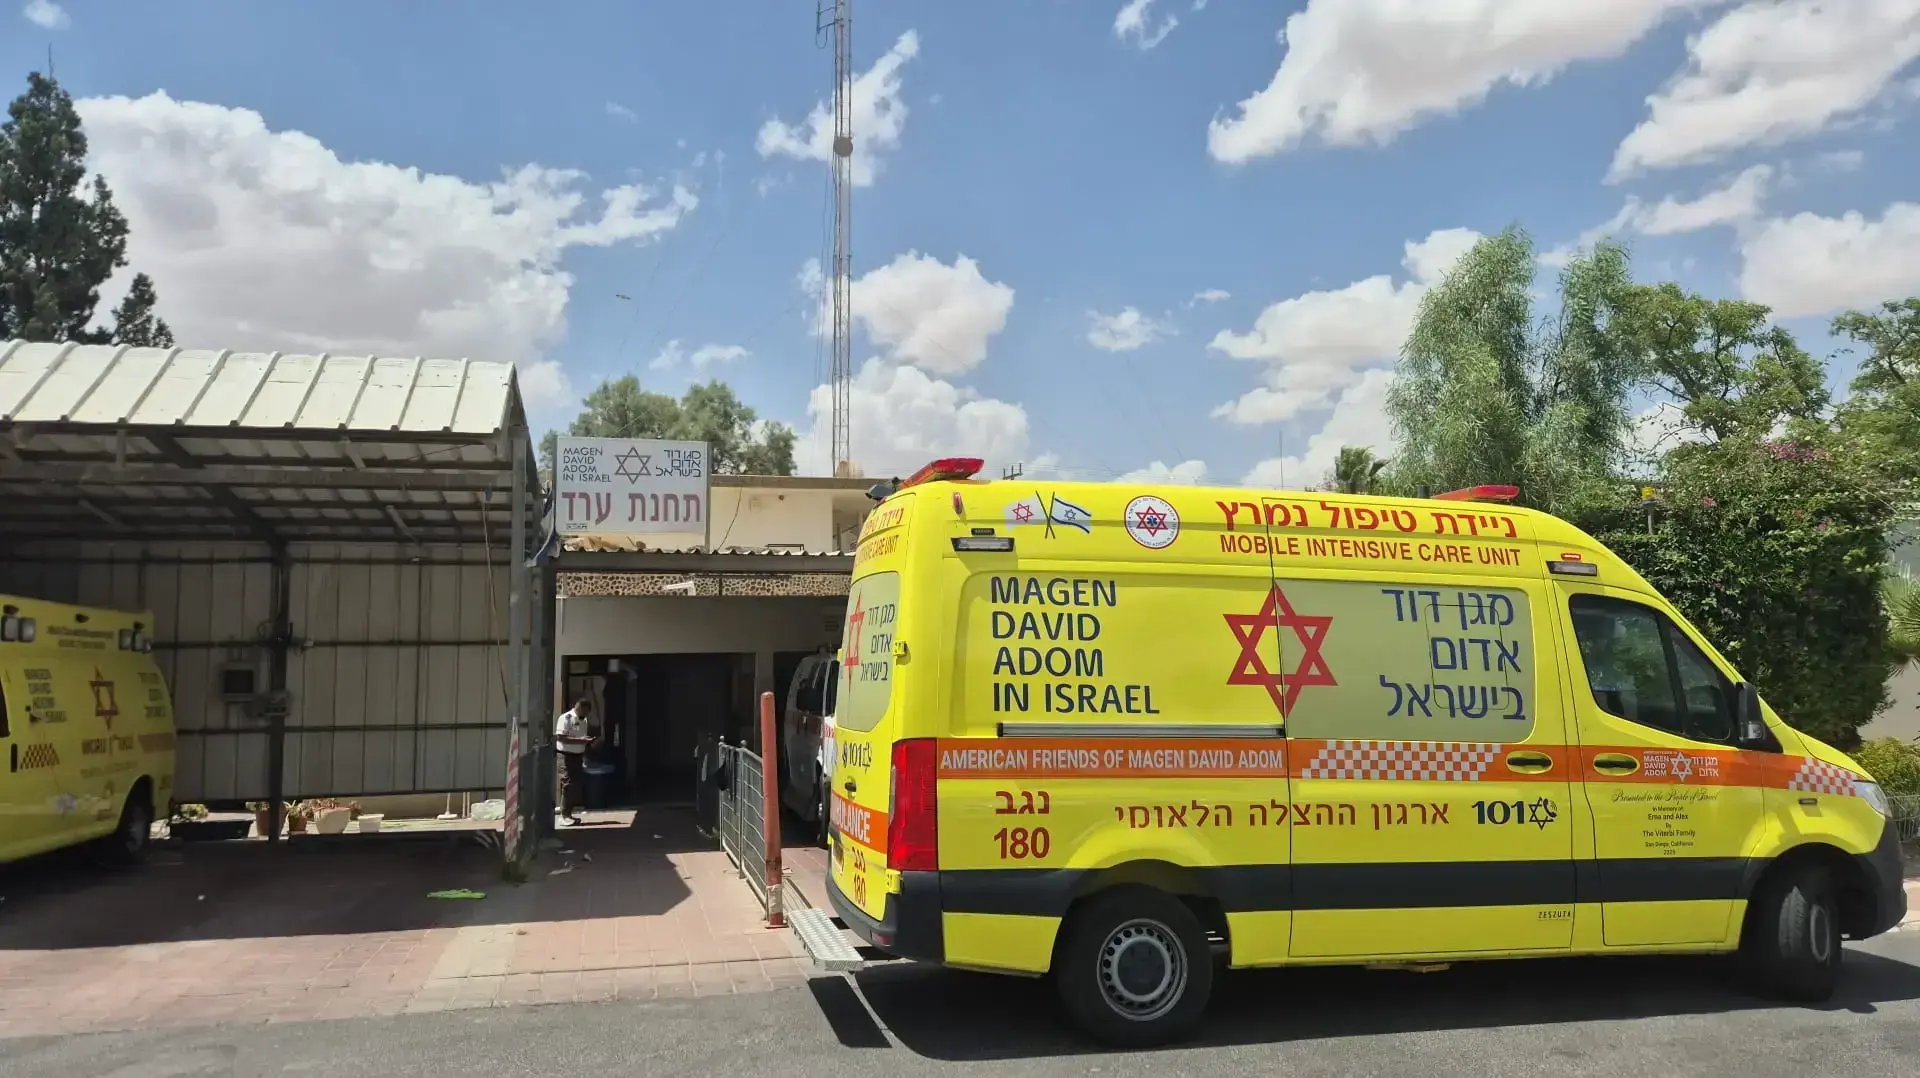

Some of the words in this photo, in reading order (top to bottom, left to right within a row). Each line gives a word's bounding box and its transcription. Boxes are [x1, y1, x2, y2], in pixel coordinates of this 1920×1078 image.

[563, 447, 603, 456] MAGEN
[563, 455, 595, 465] DAVID
[664, 449, 681, 459] דוד
[671, 459, 701, 468] אדום
[683, 450, 702, 460] מגן
[563, 464, 597, 473] ADOM
[563, 473, 573, 481] IN
[579, 473, 612, 483] ISRAEL
[655, 465, 702, 478] בישראל
[562, 491, 611, 526] ערד
[628, 492, 700, 523] תחנת
[1216, 500, 1309, 531] נמרץ
[1320, 500, 1418, 533] טיפול
[1431, 511, 1519, 539] ניידת
[1220, 534, 1300, 556] MOBILE
[1306, 538, 1413, 560] INTENSIVE
[1418, 543, 1474, 564] CARE
[1477, 547, 1521, 566] UNIT
[991, 576, 1117, 607] MAGEN
[868, 606, 880, 629] דוד
[879, 603, 896, 628] מגן
[1381, 588, 1441, 624] דוד
[1457, 591, 1515, 630] מגן
[992, 611, 1101, 641] DAVID
[871, 633, 893, 654] אדום
[1430, 636, 1522, 673] אדום
[860, 659, 888, 682] בישראל
[993, 646, 1103, 677] ADOM
[993, 682, 1029, 712] IN
[1045, 683, 1160, 714] ISRAEL
[1379, 674, 1526, 720] בישראל
[849, 742, 862, 767] 101
[940, 749, 1028, 769] AMERICAN
[1032, 749, 1100, 769] FRIENDS
[1104, 749, 1125, 769] OF
[1128, 749, 1185, 769] MAGEN
[1188, 750, 1234, 769] DAVID
[1238, 750, 1283, 768] ADOM
[1644, 769, 1667, 777] ADOM
[994, 789, 1050, 815] נגב
[1114, 800, 1233, 829] הלאומי
[1249, 799, 1356, 825] ההצלה
[1471, 800, 1524, 825] 101
[1371, 802, 1450, 830] ארגון
[993, 827, 1050, 859] 180
[853, 874, 866, 907] 180
